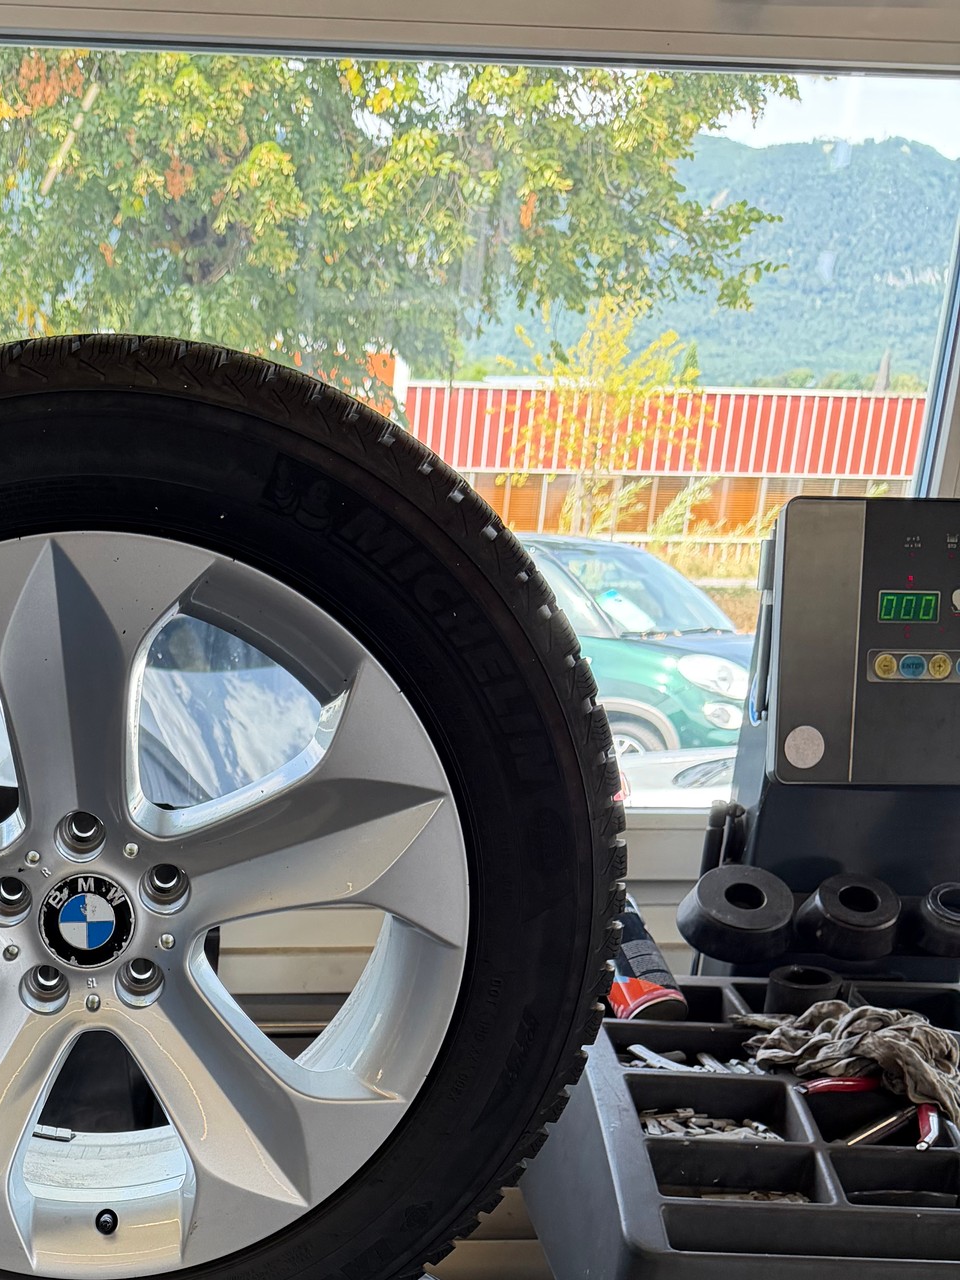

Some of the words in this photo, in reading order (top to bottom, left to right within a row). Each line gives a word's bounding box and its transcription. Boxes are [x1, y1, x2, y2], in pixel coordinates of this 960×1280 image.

[881, 596, 936, 620] 000
[339, 505, 561, 787] MICHELIN
[48, 877, 126, 910] BMW
